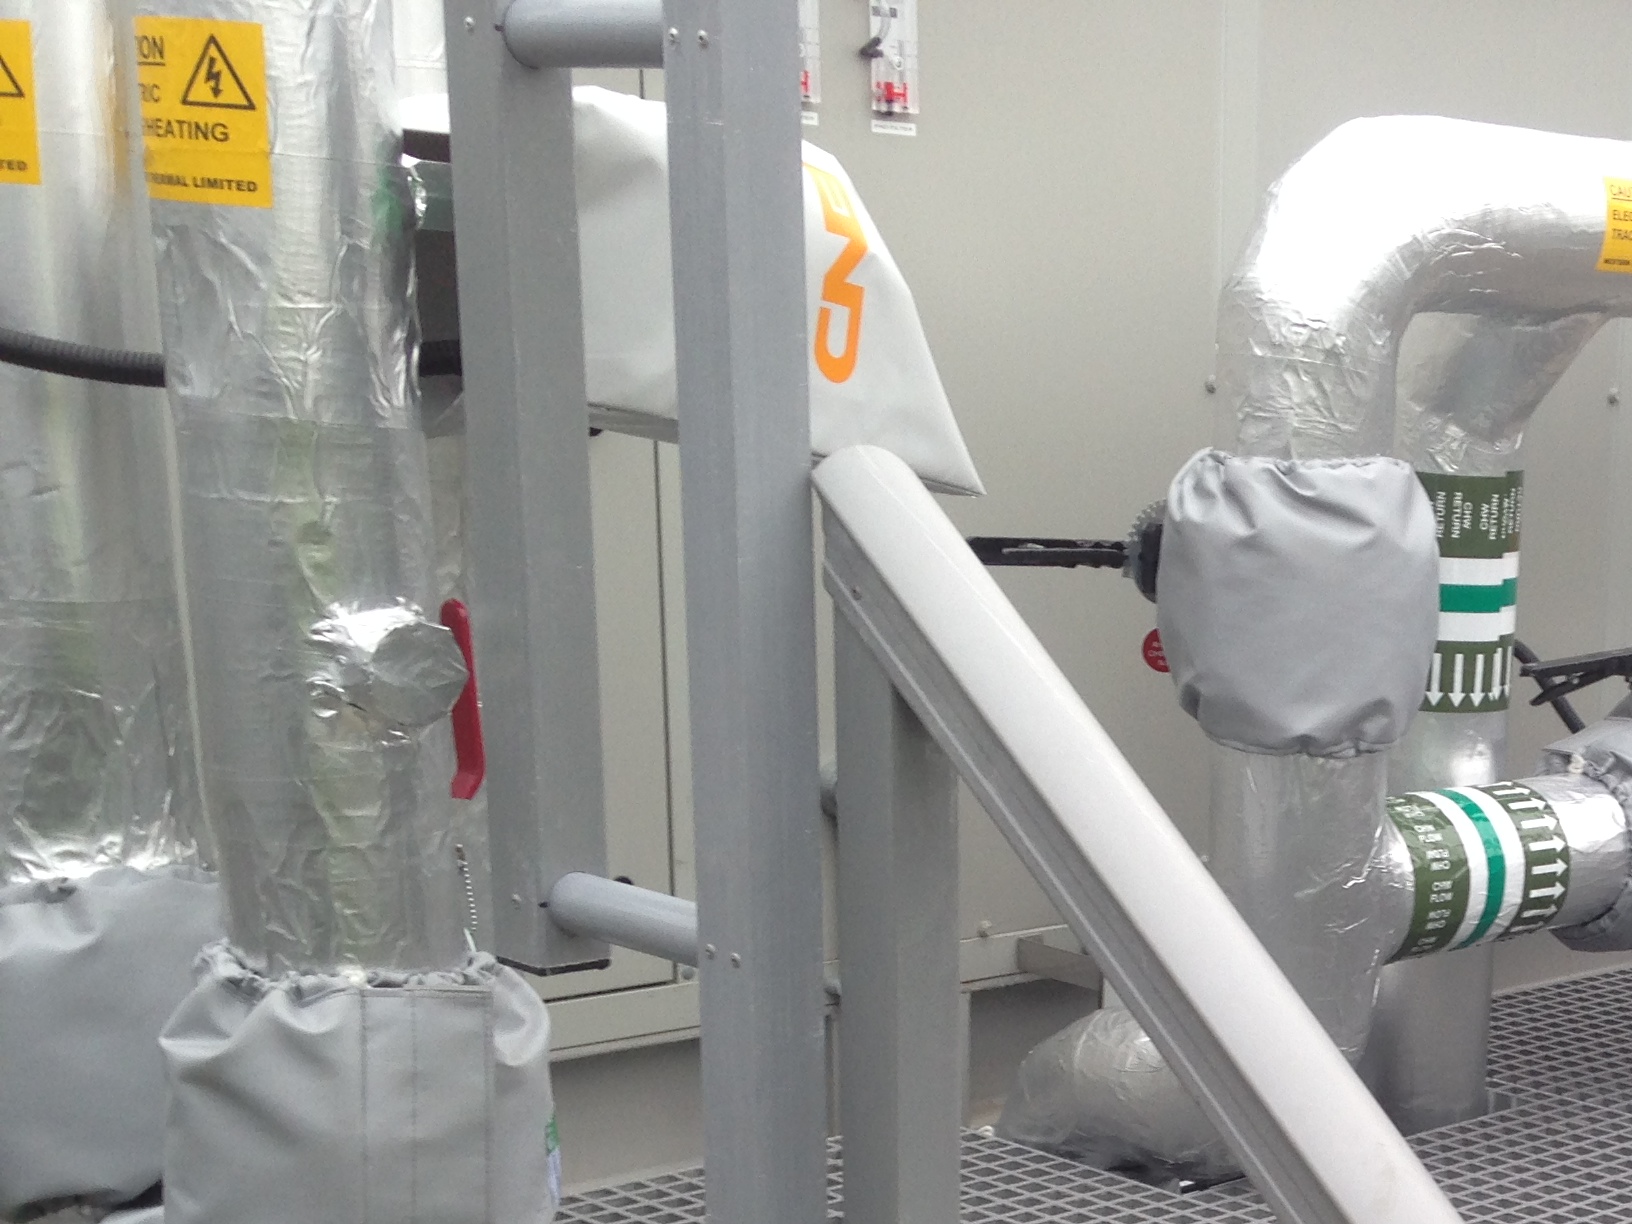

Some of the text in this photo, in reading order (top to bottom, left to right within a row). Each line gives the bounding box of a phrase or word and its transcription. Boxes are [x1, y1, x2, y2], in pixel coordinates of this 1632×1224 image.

[192, 176, 258, 192] LIMITED
[1451, 491, 1463, 538] RETURN
[1463, 502, 1474, 530] CHW
[1480, 503, 1489, 531] CHW
[1489, 493, 1499, 540] RETURN
[1429, 892, 1454, 904] FLOW
